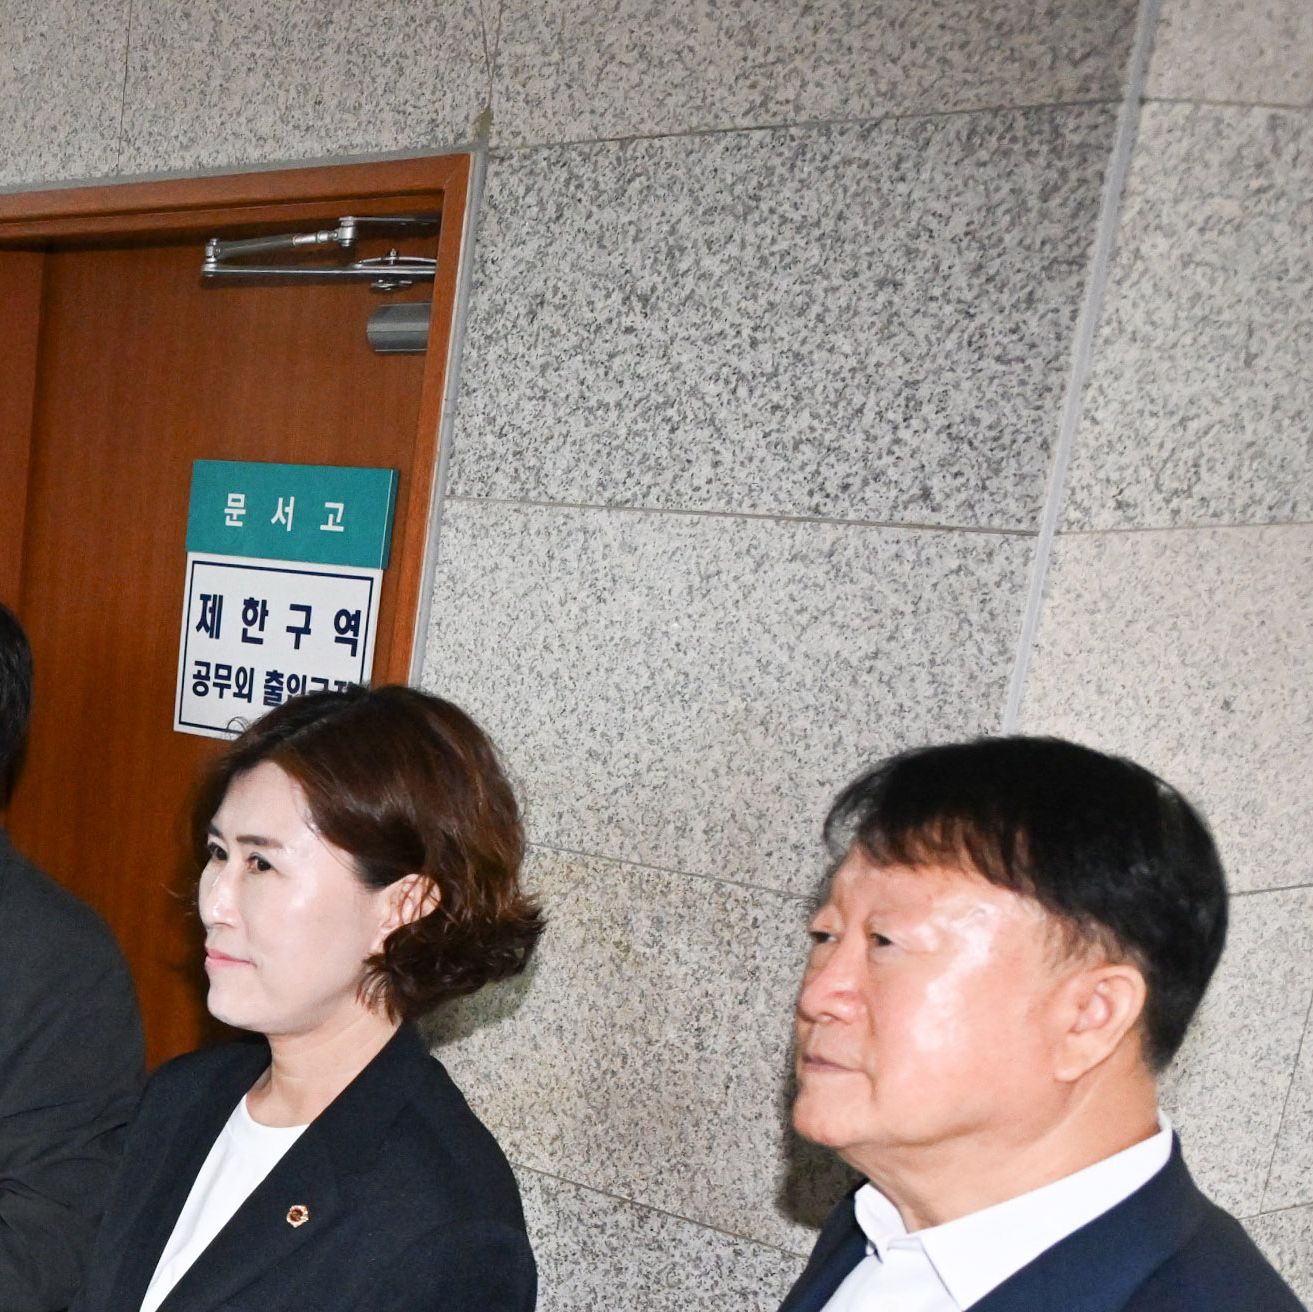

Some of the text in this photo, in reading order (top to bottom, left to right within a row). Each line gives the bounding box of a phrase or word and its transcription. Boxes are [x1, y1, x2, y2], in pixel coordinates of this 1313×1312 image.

[224, 493, 345, 532] 문서고
[196, 593, 362, 657] 제한구역
[192, 660, 255, 703] 공무외
